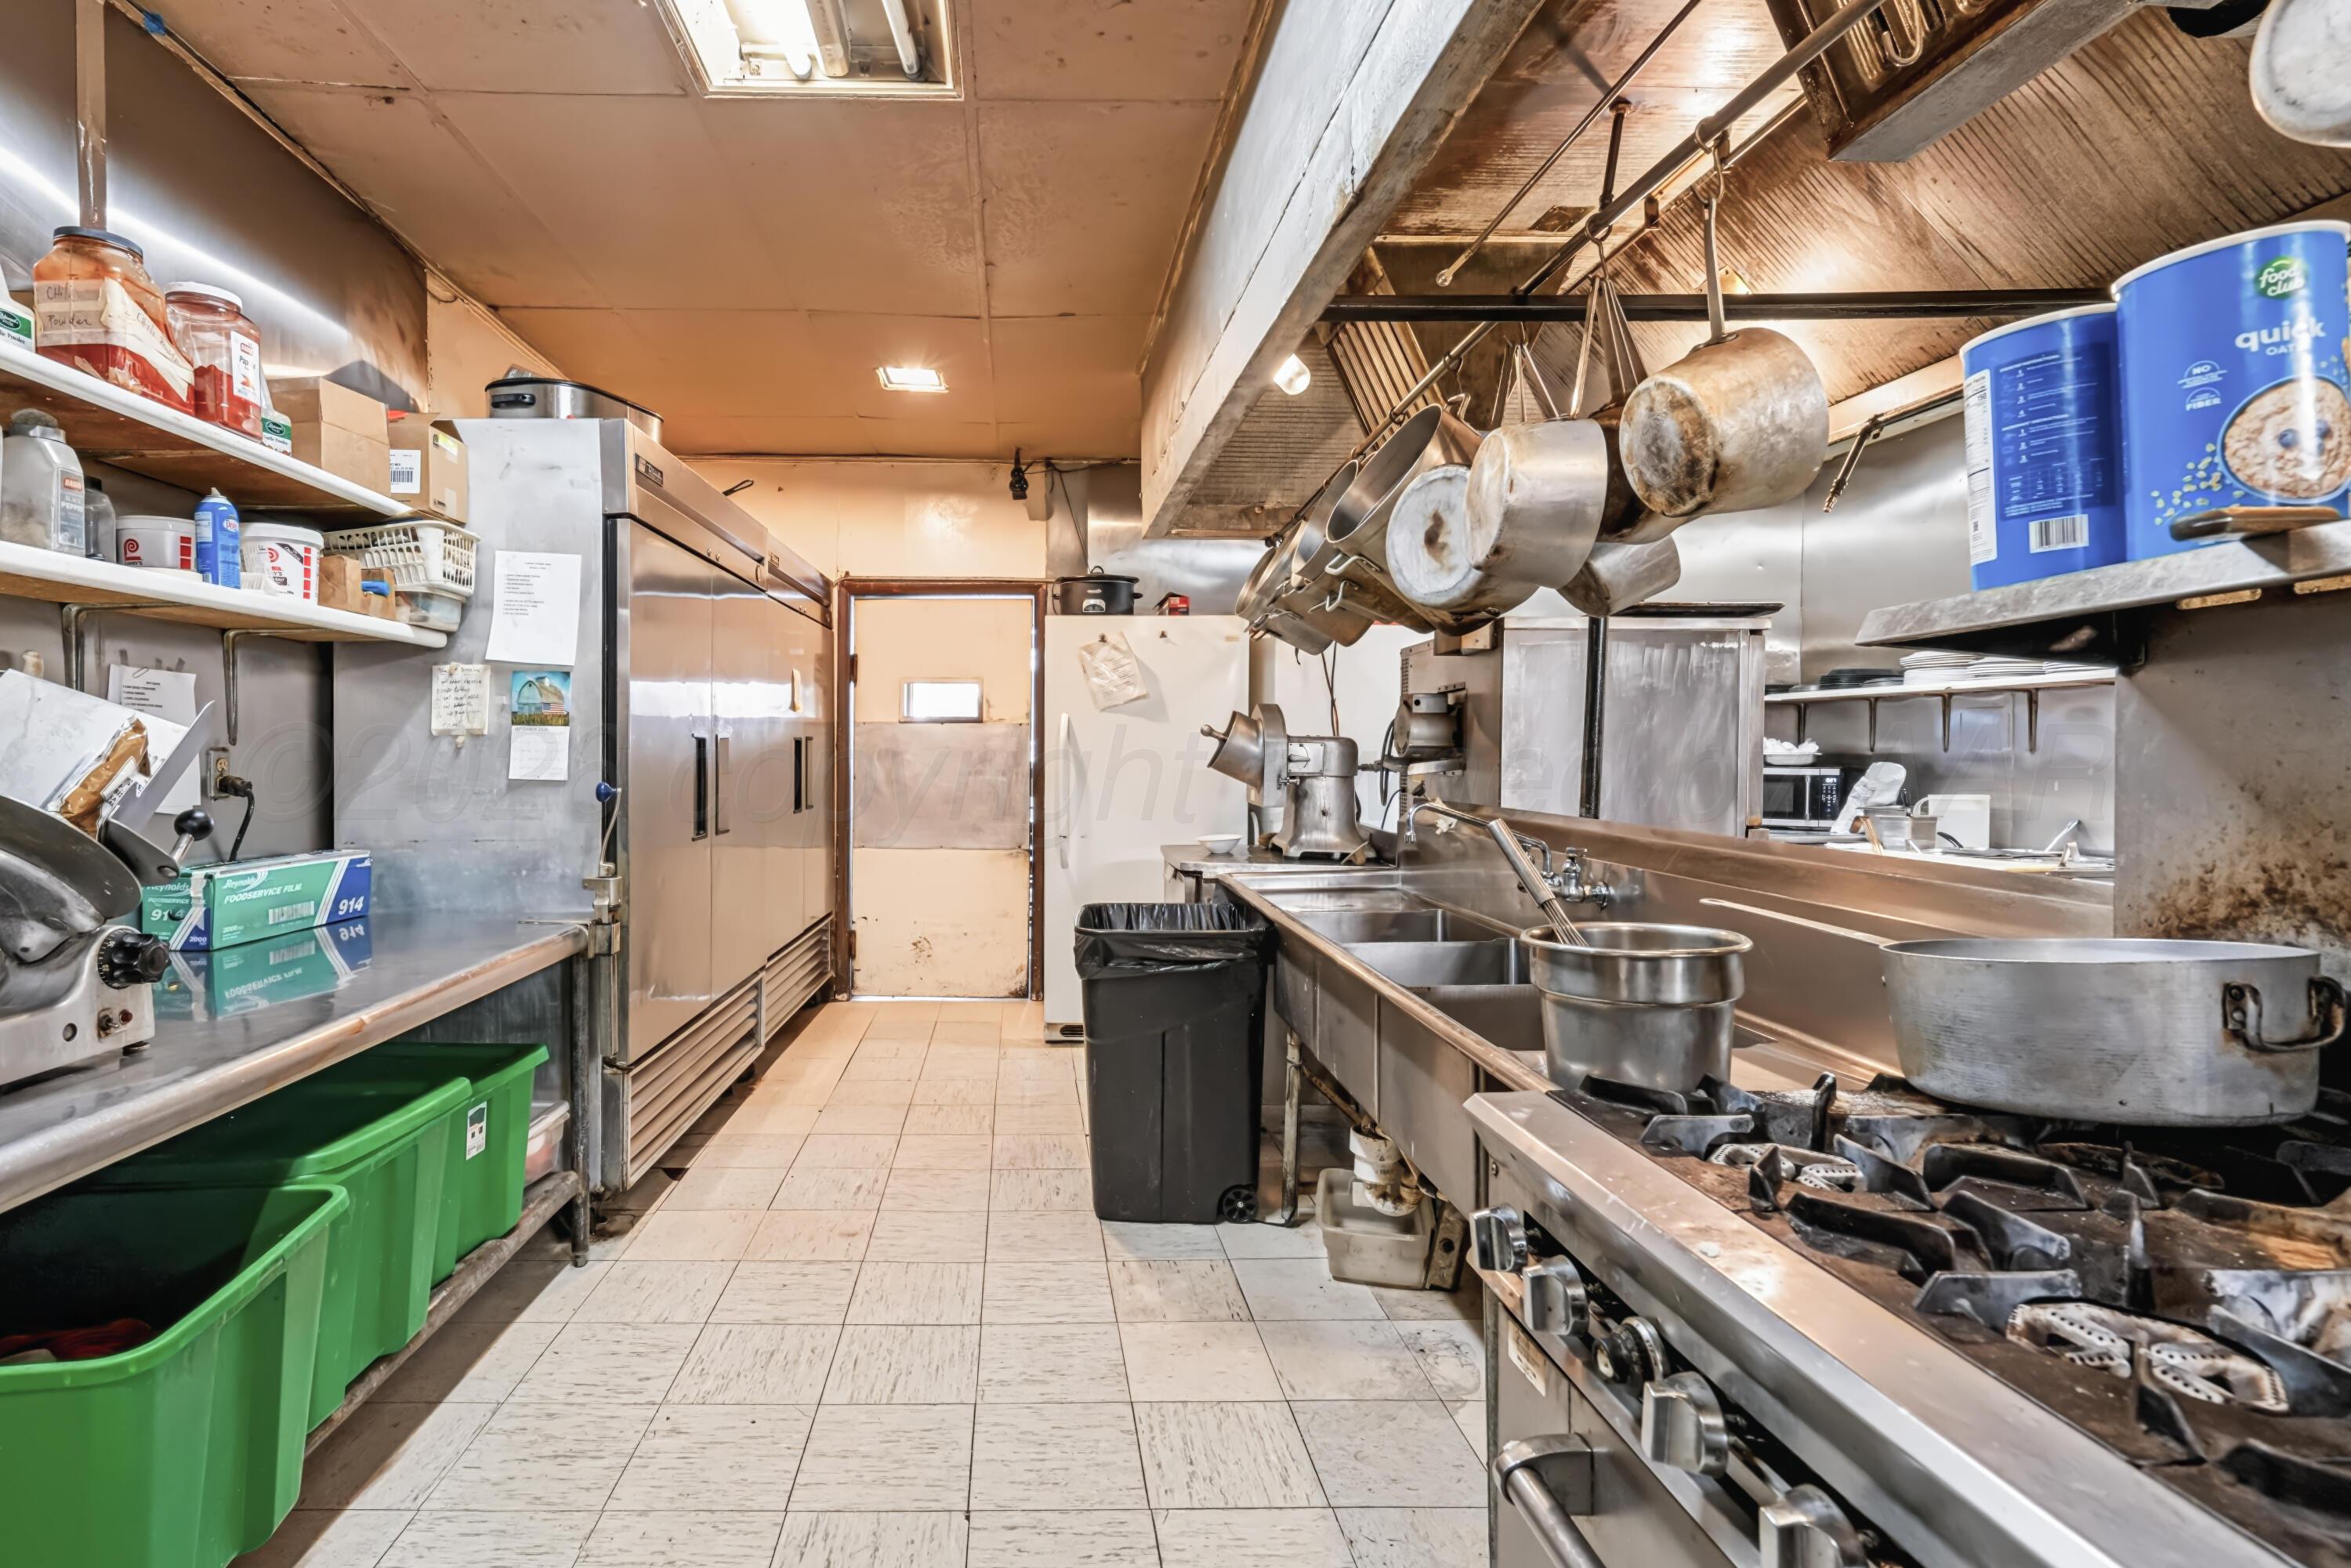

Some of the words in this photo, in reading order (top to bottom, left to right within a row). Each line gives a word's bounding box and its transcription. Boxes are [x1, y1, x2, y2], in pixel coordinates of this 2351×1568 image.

[2259, 262, 2300, 289] food
[2266, 273, 2305, 297] club
[2235, 316, 2327, 353] quick
[2265, 342, 2306, 356] OAT
[2192, 364, 2212, 375] NO
[2185, 397, 2222, 411] FIBER
[222, 877, 257, 890] Reynolds
[224, 886, 282, 904] FOODSERVICE
[283, 883, 302, 893] FILM
[338, 896, 365, 916] 914
